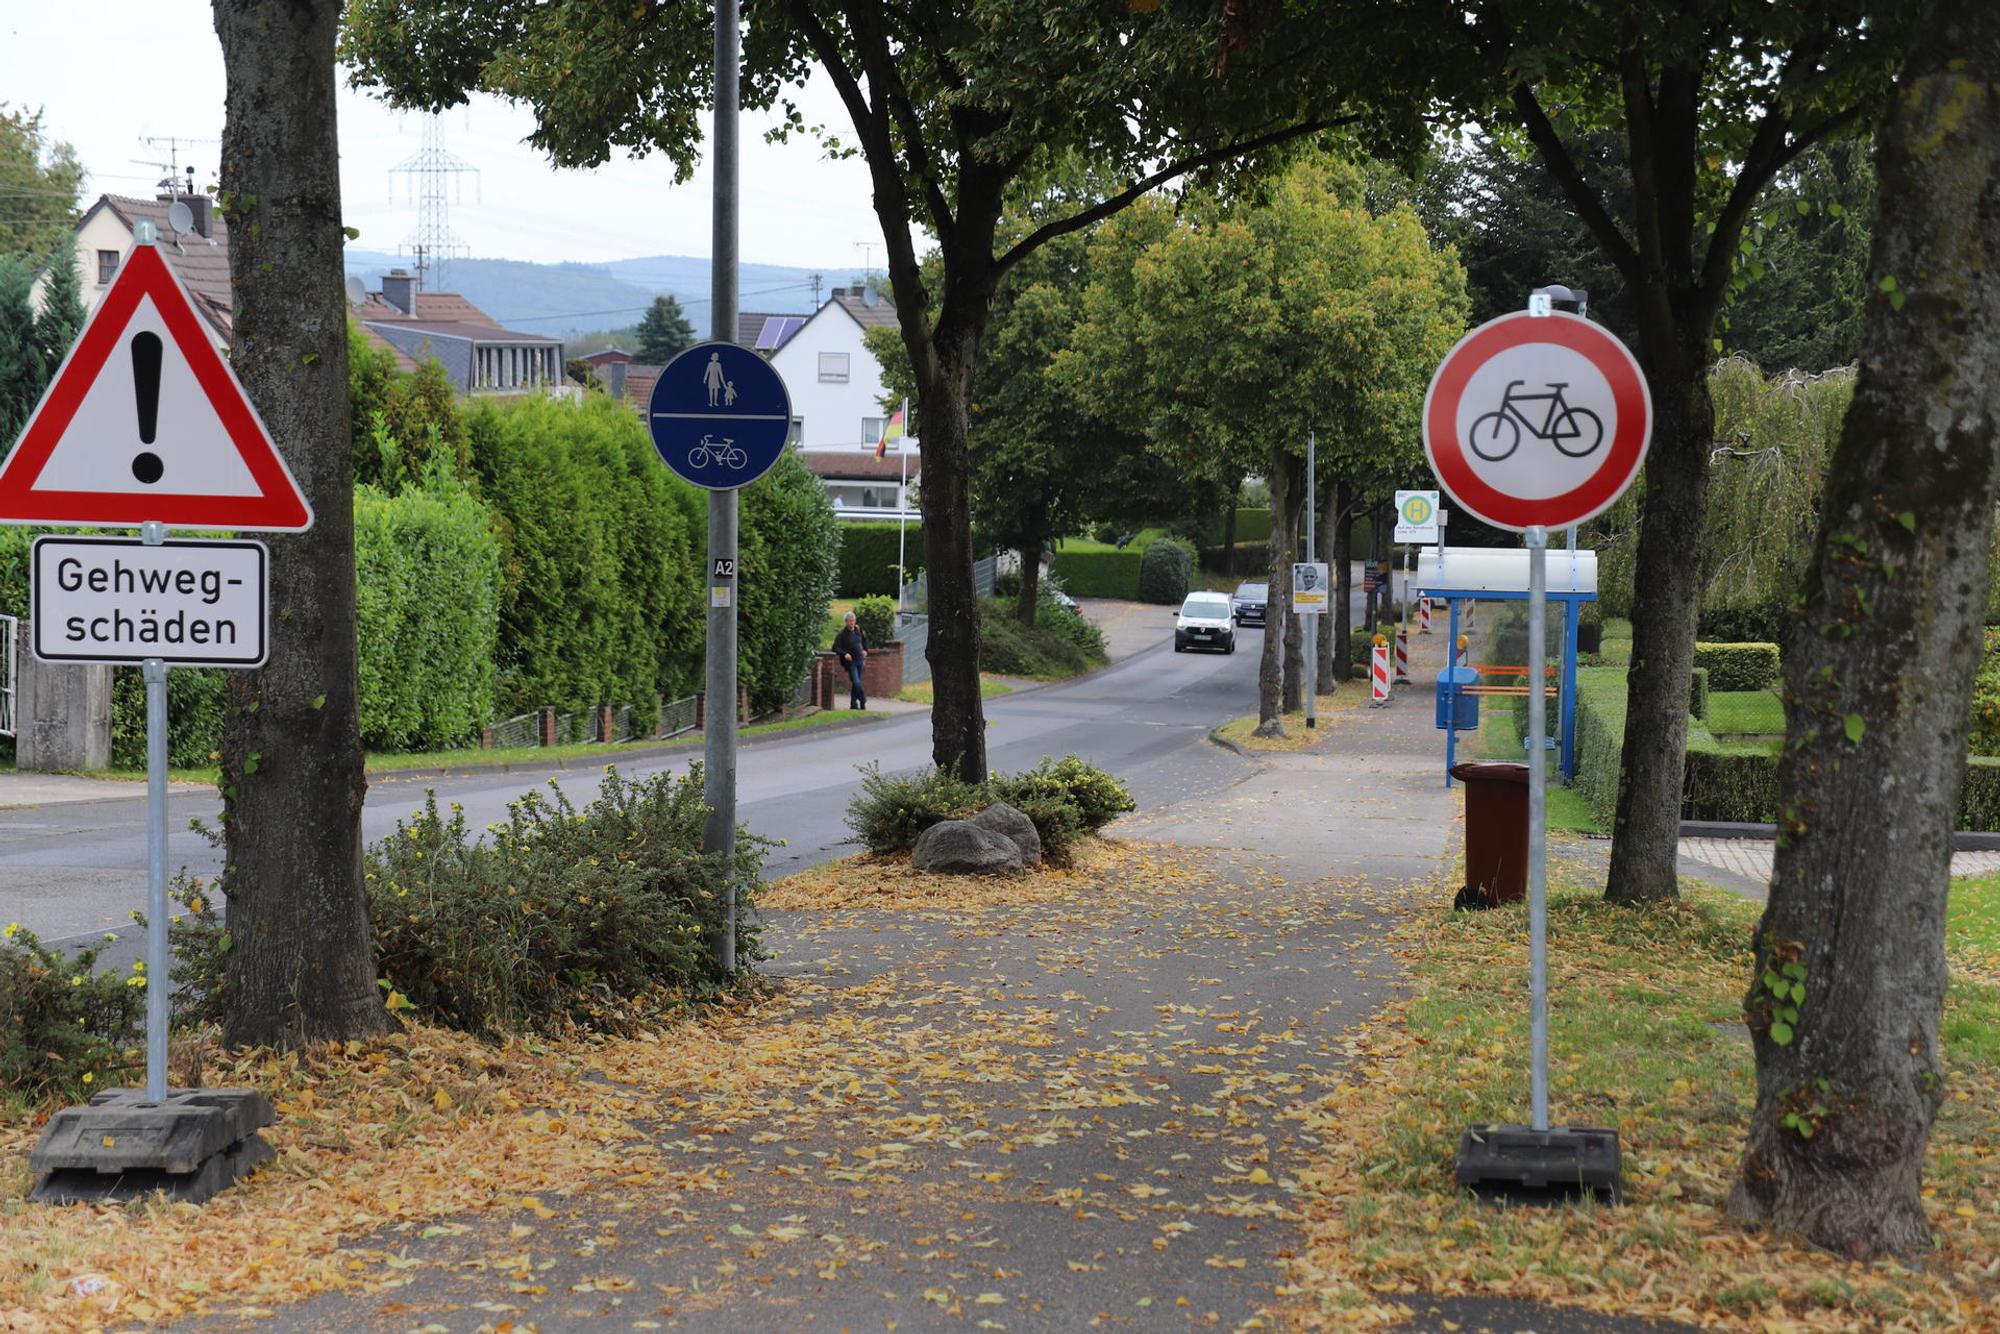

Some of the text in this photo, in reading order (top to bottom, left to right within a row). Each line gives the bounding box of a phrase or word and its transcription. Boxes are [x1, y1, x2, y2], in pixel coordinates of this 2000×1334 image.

[58, 558, 242, 604] Gehweg-
[715, 560, 733, 575] A2
[65, 608, 236, 644] schäden
